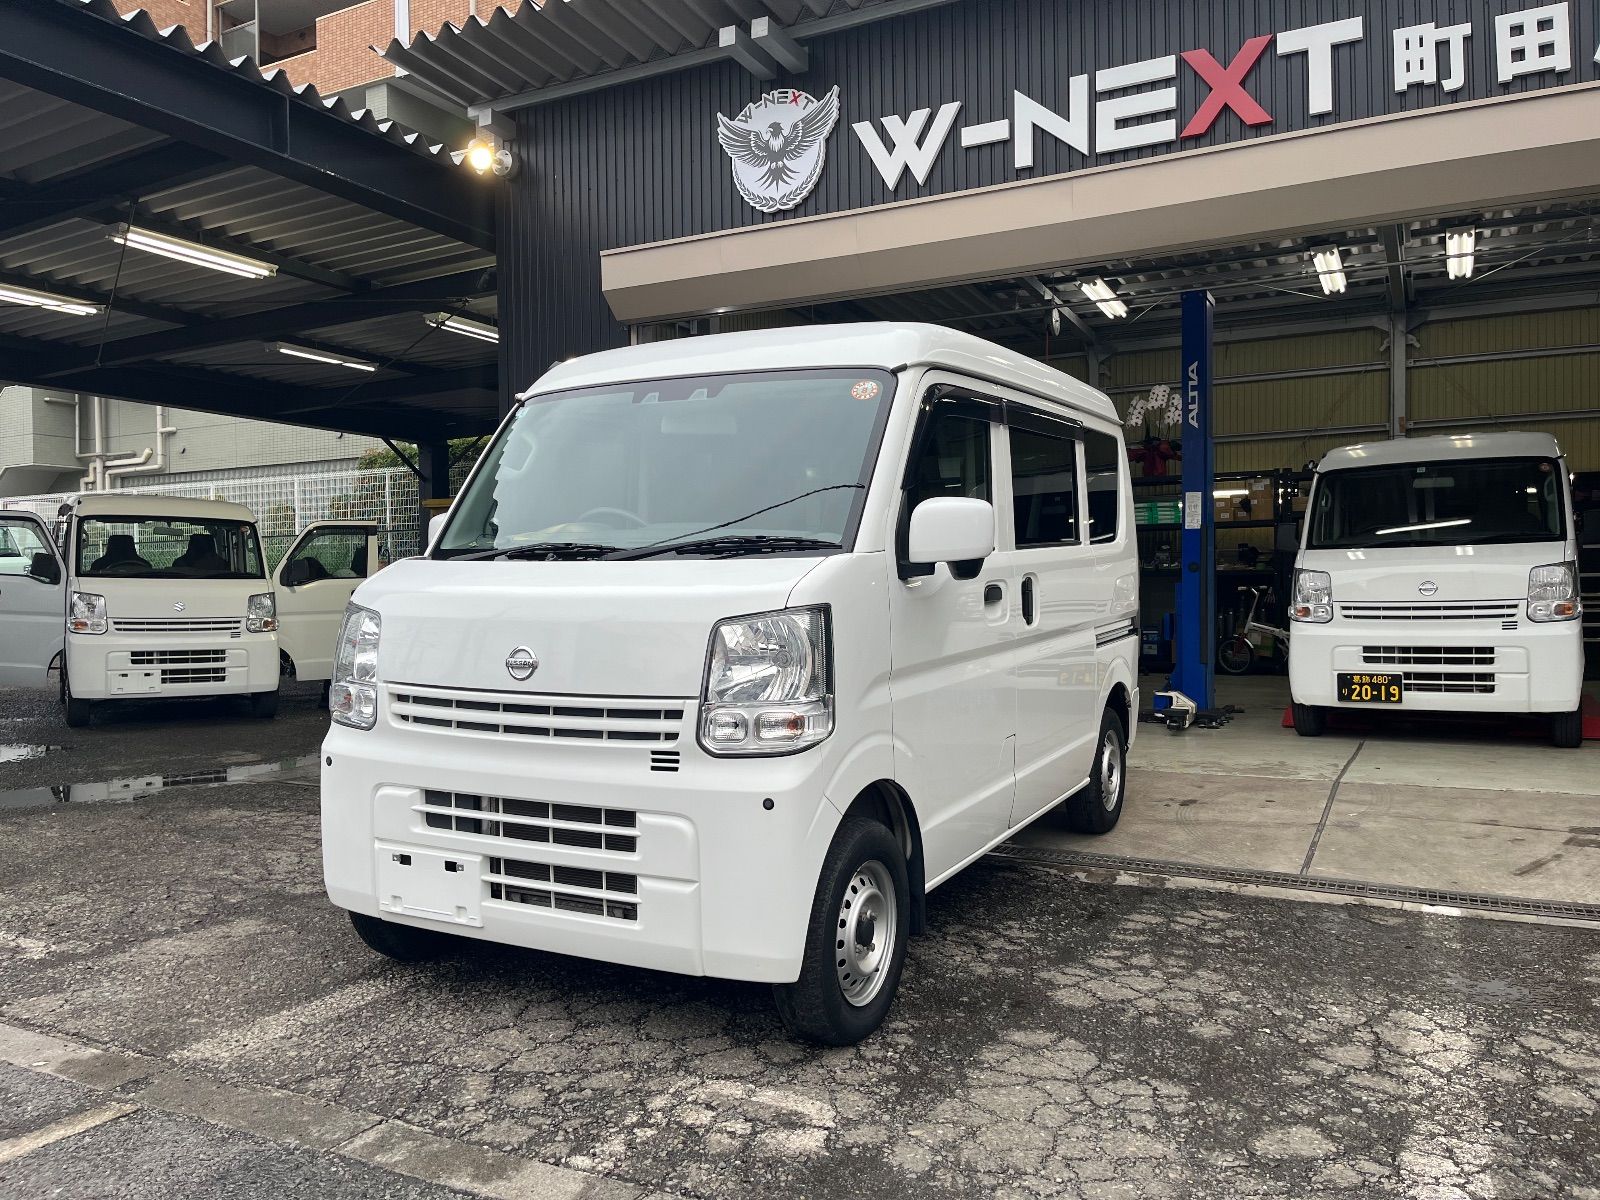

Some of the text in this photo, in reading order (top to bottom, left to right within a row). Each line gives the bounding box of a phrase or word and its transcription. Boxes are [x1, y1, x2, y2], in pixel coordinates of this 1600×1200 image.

[736, 90, 815, 124] W-NEXT
[851, 2, 1600, 192] W-NEXT 町田
[1188, 360, 1199, 429] ALTIA
[1351, 685, 1399, 701] 20-19
